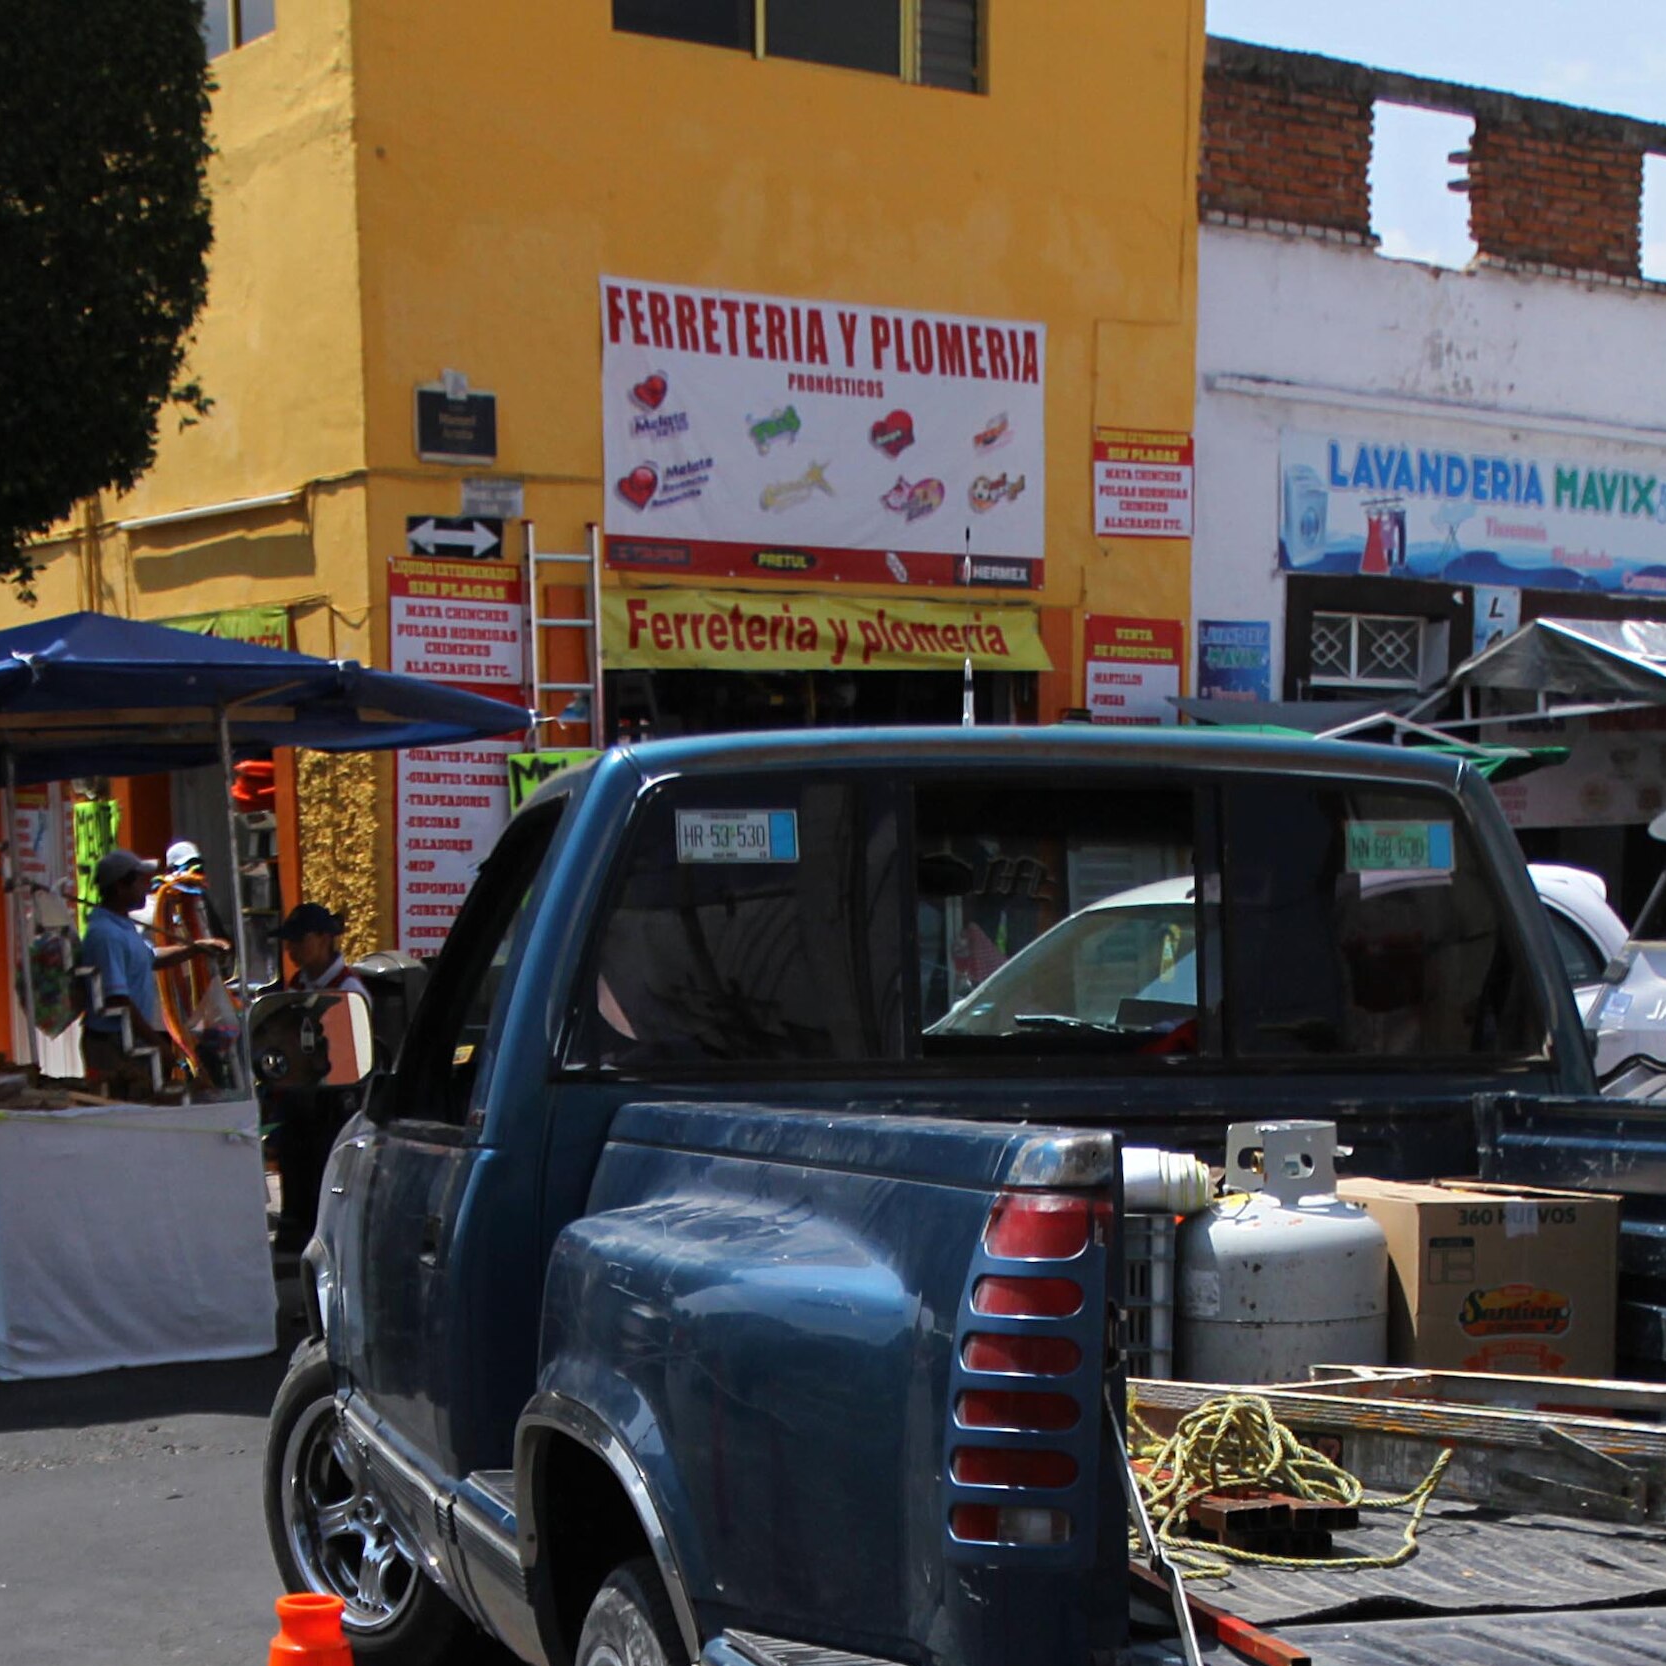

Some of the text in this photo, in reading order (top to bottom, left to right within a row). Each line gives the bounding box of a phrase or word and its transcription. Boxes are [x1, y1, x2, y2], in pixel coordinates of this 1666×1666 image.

[606, 285, 1039, 384] FERRETERIA Y PLOMERIA
[1328, 440, 1658, 517] LAVANDERIA MAVIX
[758, 551, 808, 569] PRETUL
[972, 564, 1029, 582] HERMEX
[408, 581, 506, 600] SIN PLAGAS
[406, 604, 509, 622] MATA CHINCHES
[397, 623, 517, 643] PULGAS HORMIGAS
[626, 599, 1010, 664] Ferreteria y plomeria
[1115, 628, 1153, 641] VENTA
[404, 660, 482, 677] ALACRANES
[463, 752, 508, 765] PLASTIC
[1457, 1207, 1494, 1227] 360
